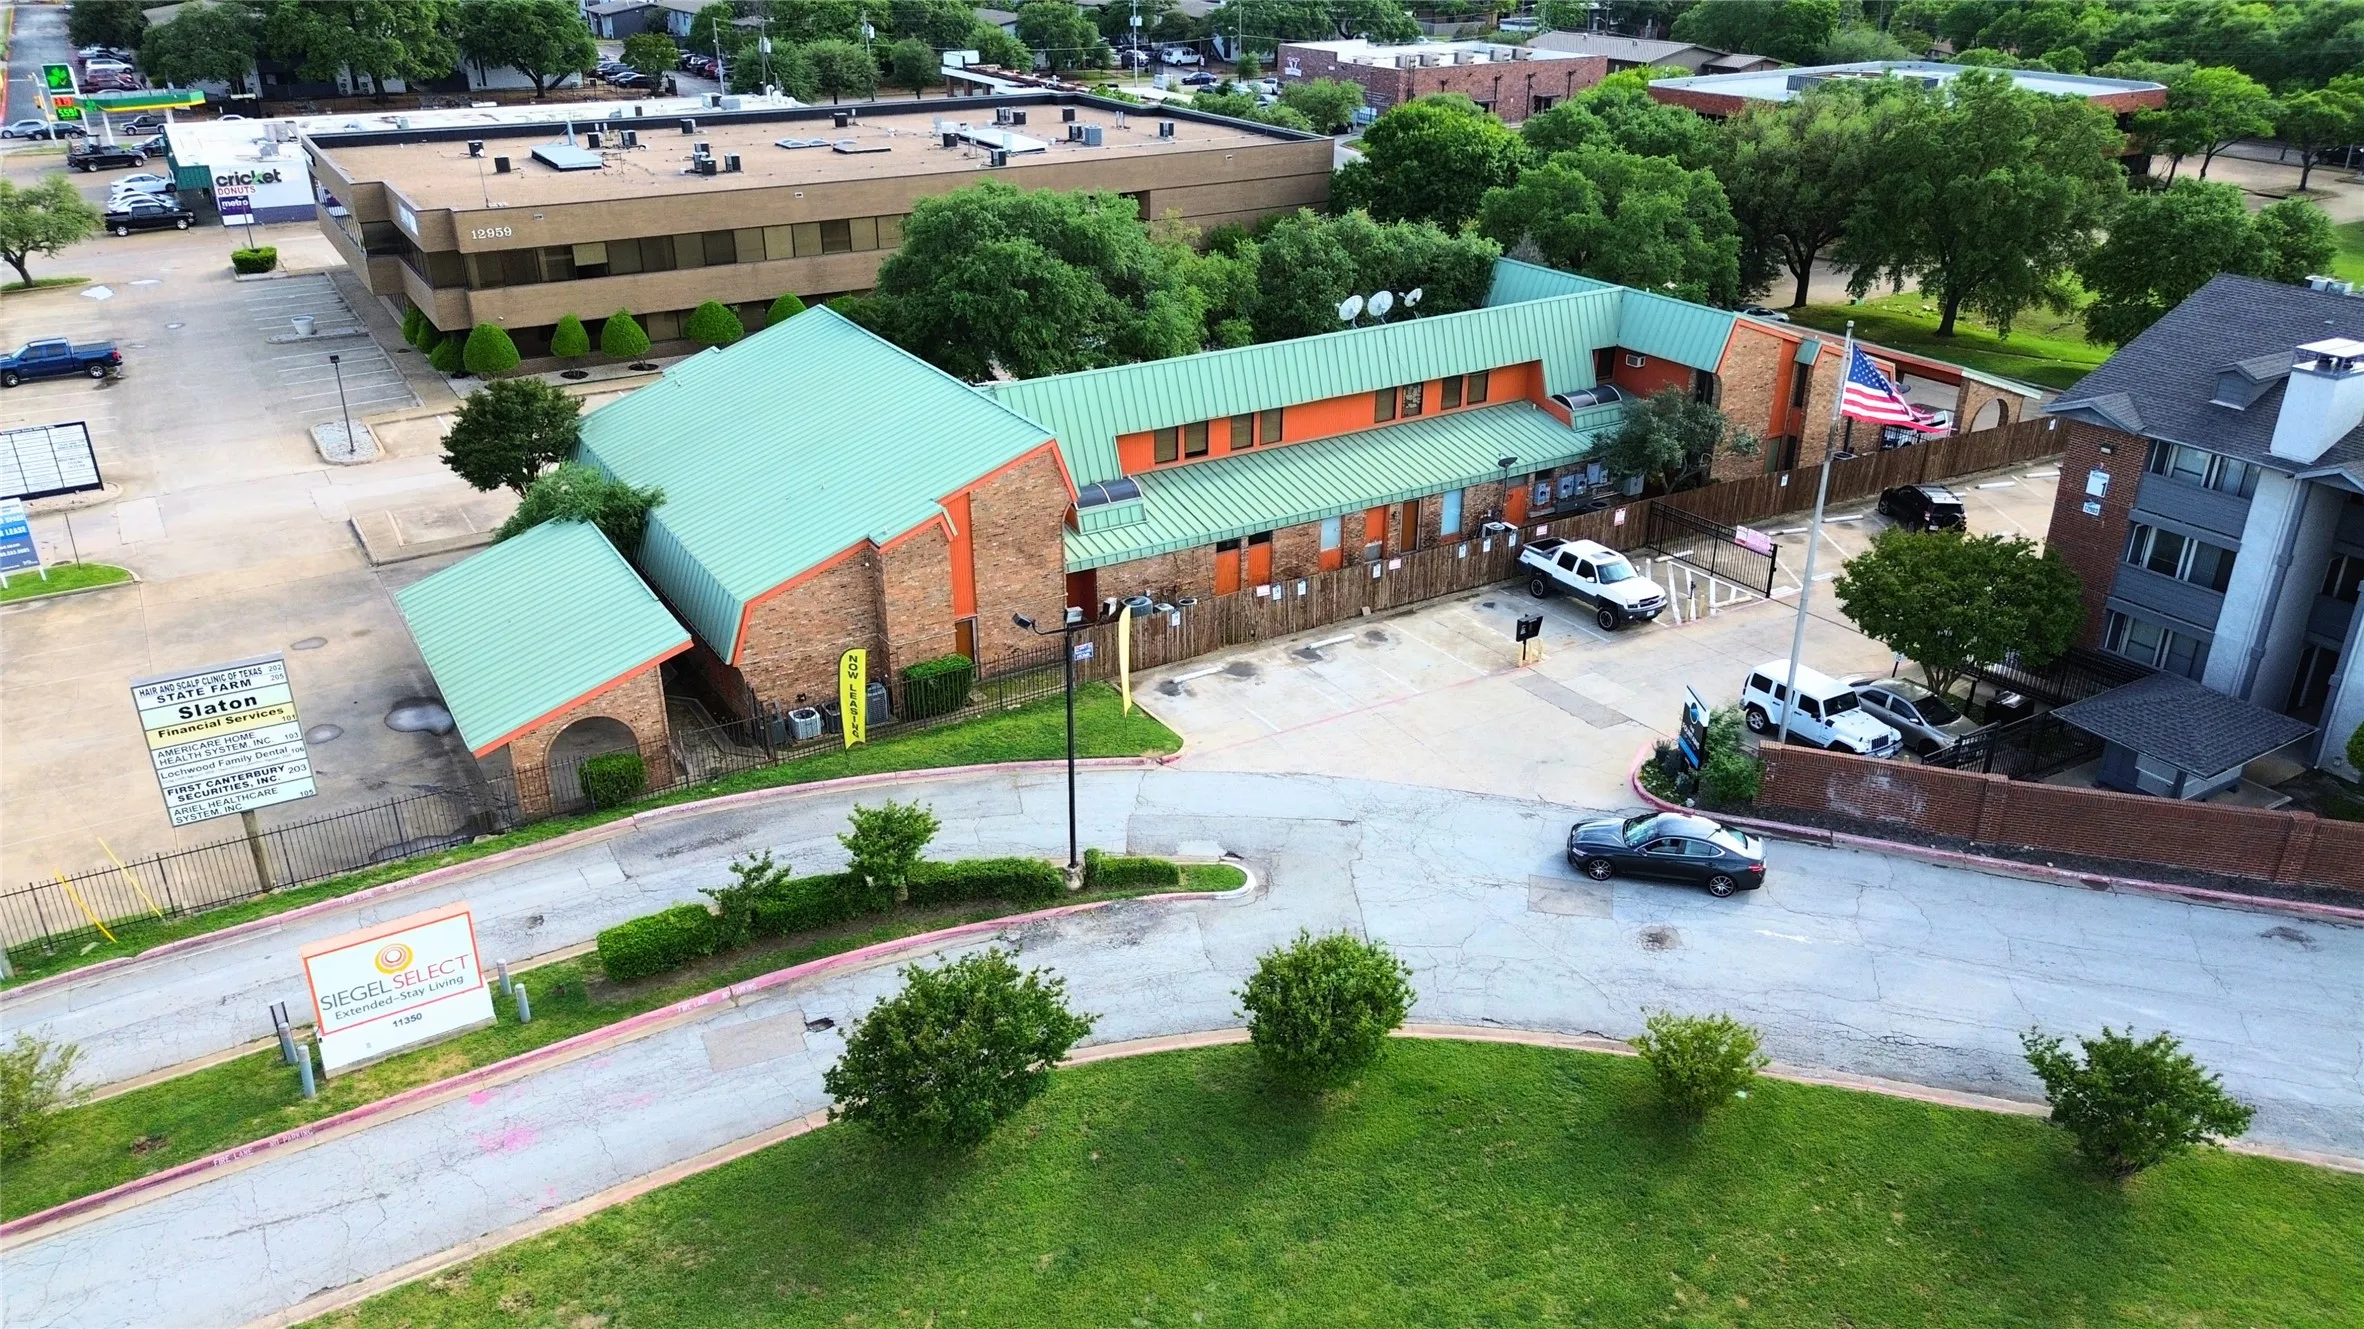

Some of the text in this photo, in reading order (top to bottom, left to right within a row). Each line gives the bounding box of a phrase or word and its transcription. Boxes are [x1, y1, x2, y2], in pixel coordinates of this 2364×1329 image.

[215, 168, 282, 187] cricket
[217, 185, 256, 196] DONUTS
[221, 199, 249, 207] metro
[471, 226, 512, 239] 12959
[5, 526, 27, 536] LEASE
[139, 664, 282, 697] HAIR AND SCALP CLINIC OF TEXAS 202
[848, 655, 858, 680] NOW
[157, 673, 285, 704] STATE FARM 205
[178, 696, 258, 720] Slaton
[282, 714, 297, 722] 101
[849, 684, 859, 738] LEASING
[158, 707, 284, 738] Financial Services
[157, 732, 257, 758] AMERICARE HOME
[159, 751, 202, 767] HEALTH
[253, 736, 275, 746] INC.
[284, 732, 299, 740] 103
[160, 762, 216, 780] Lochwood
[218, 753, 252, 767] Family
[255, 746, 288, 759] Dental
[167, 782, 202, 796] FIRST
[205, 765, 285, 788] CANTERBURY
[287, 764, 307, 774] 203
[177, 775, 281, 803] SECURITIES, INC.
[174, 788, 314, 817] ARIEL HEALTHCARE 105
[320, 954, 469, 1012] SIEGEL SELECT
[428, 975, 465, 992] Living
[392, 1012, 423, 1028] 11350
[213, 1154, 232, 1167] FIRE
[233, 1147, 255, 1160] LANE
[283, 1128, 314, 1144] PARKING
